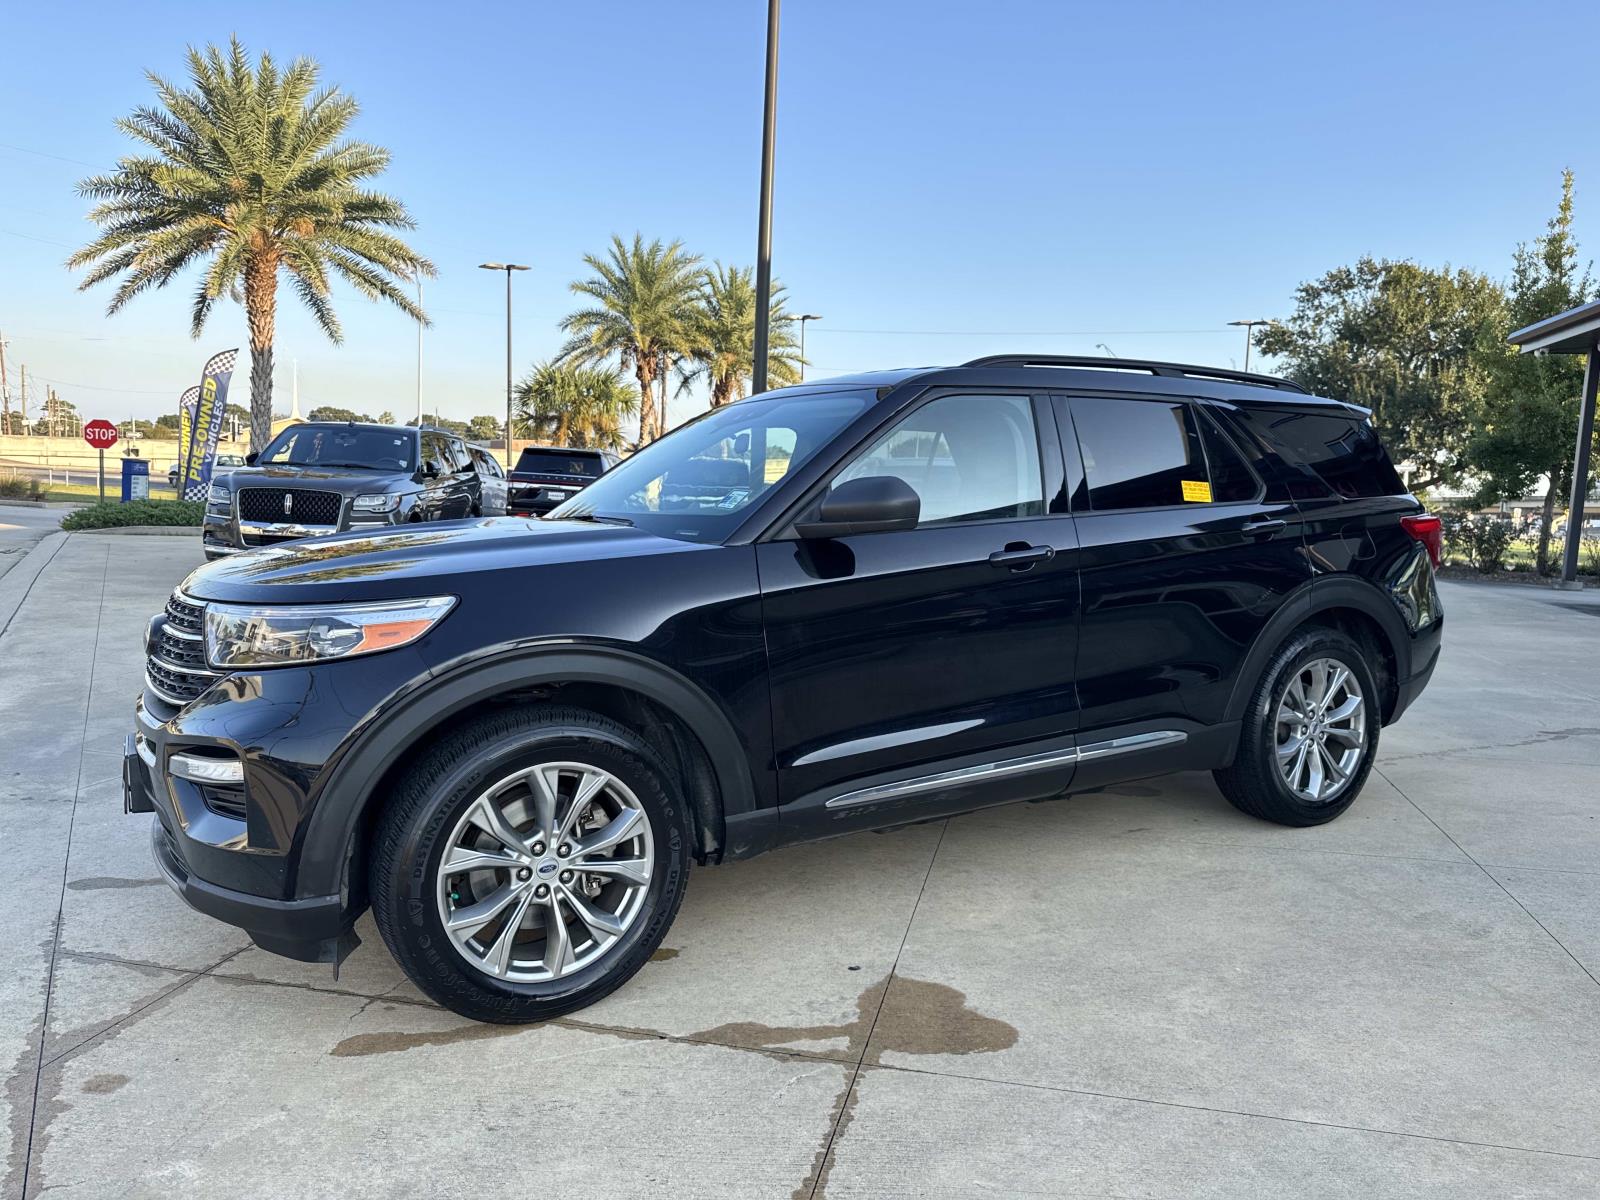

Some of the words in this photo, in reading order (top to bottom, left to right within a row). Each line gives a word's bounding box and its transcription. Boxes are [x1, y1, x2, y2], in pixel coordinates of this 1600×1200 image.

[86, 428, 116, 440] STOP
[189, 377, 217, 482] PRE-OWNED
[205, 400, 224, 463] VEHICLES
[413, 785, 467, 879] DESTINATION
